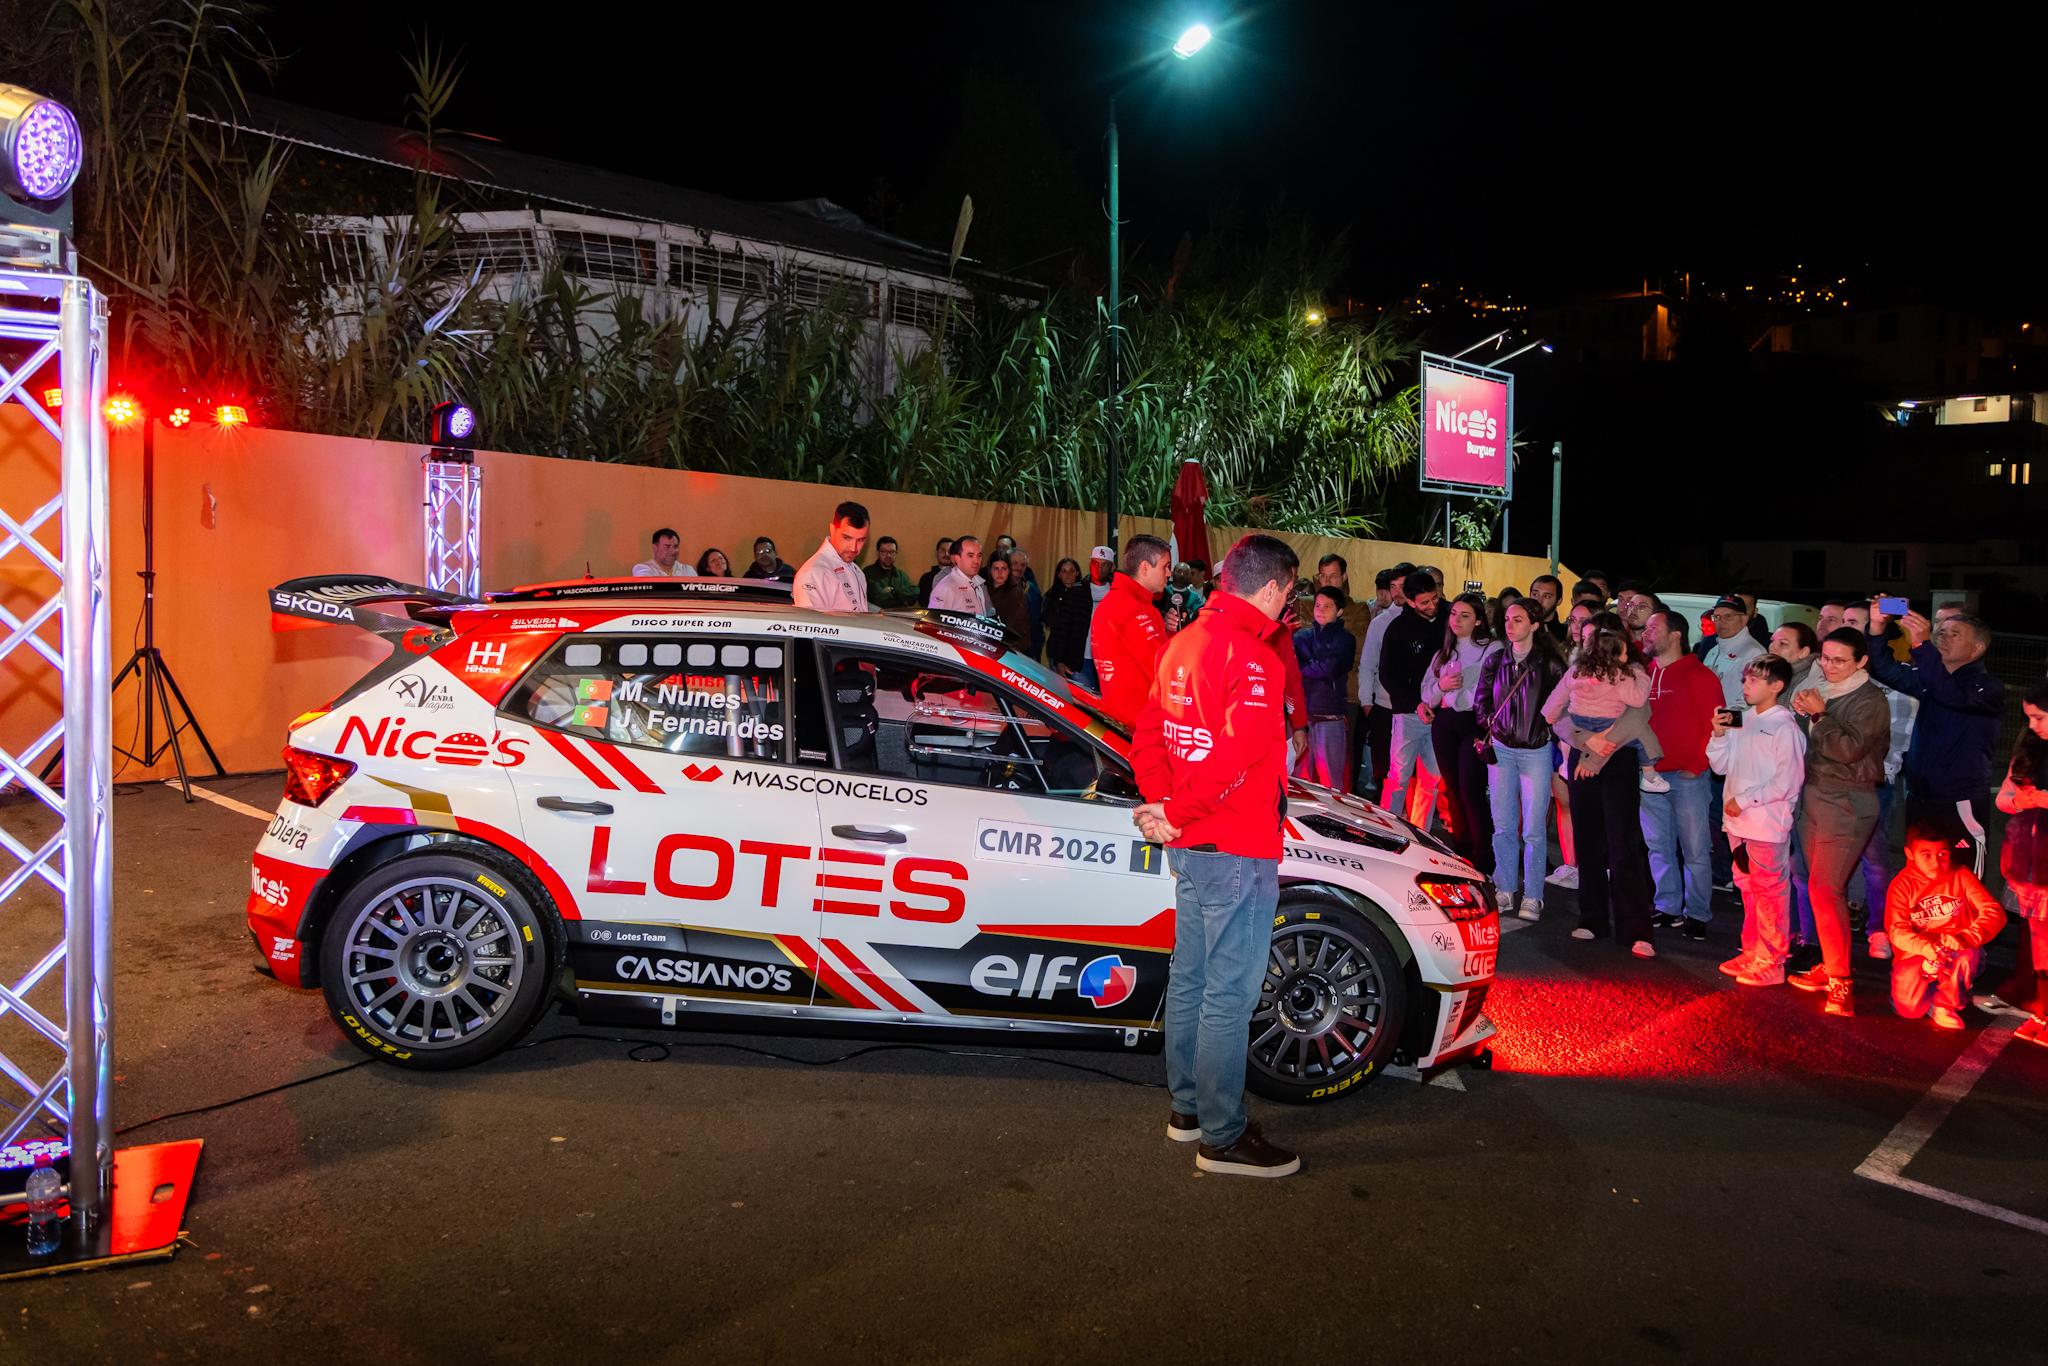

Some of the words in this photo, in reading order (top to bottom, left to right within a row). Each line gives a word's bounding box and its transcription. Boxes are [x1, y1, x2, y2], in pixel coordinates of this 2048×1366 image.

[1466, 441, 1496, 458] Burguer
[563, 586, 609, 594] VASCONCELOS
[681, 583, 739, 592] virtualcar
[274, 593, 355, 622] SKODA
[512, 617, 557, 625] SILVEIRA
[671, 619, 704, 627] SUPER
[707, 620, 732, 628] SOM
[788, 624, 839, 635] RETIRAM
[940, 614, 1004, 638] TOMIAUTO
[883, 636, 939, 650] VULCANIZADORA
[465, 664, 501, 674] HiHome
[618, 680, 648, 703] M.
[657, 684, 741, 710] Nunes
[1001, 668, 1065, 710] virtualcar
[615, 708, 638, 730] J.
[646, 710, 785, 741] Fernandes
[334, 715, 530, 767] Nico's
[732, 769, 928, 806] MVASCONCELOS
[979, 828, 1042, 857] CMR
[1049, 836, 1116, 865] 2026
[1140, 845, 1151, 871] 1
[586, 825, 969, 924] LOTES
[616, 932, 641, 941] Lotes
[642, 932, 666, 942] Team
[615, 955, 792, 992] CASSIANO'S
[970, 953, 1078, 1000] elf
